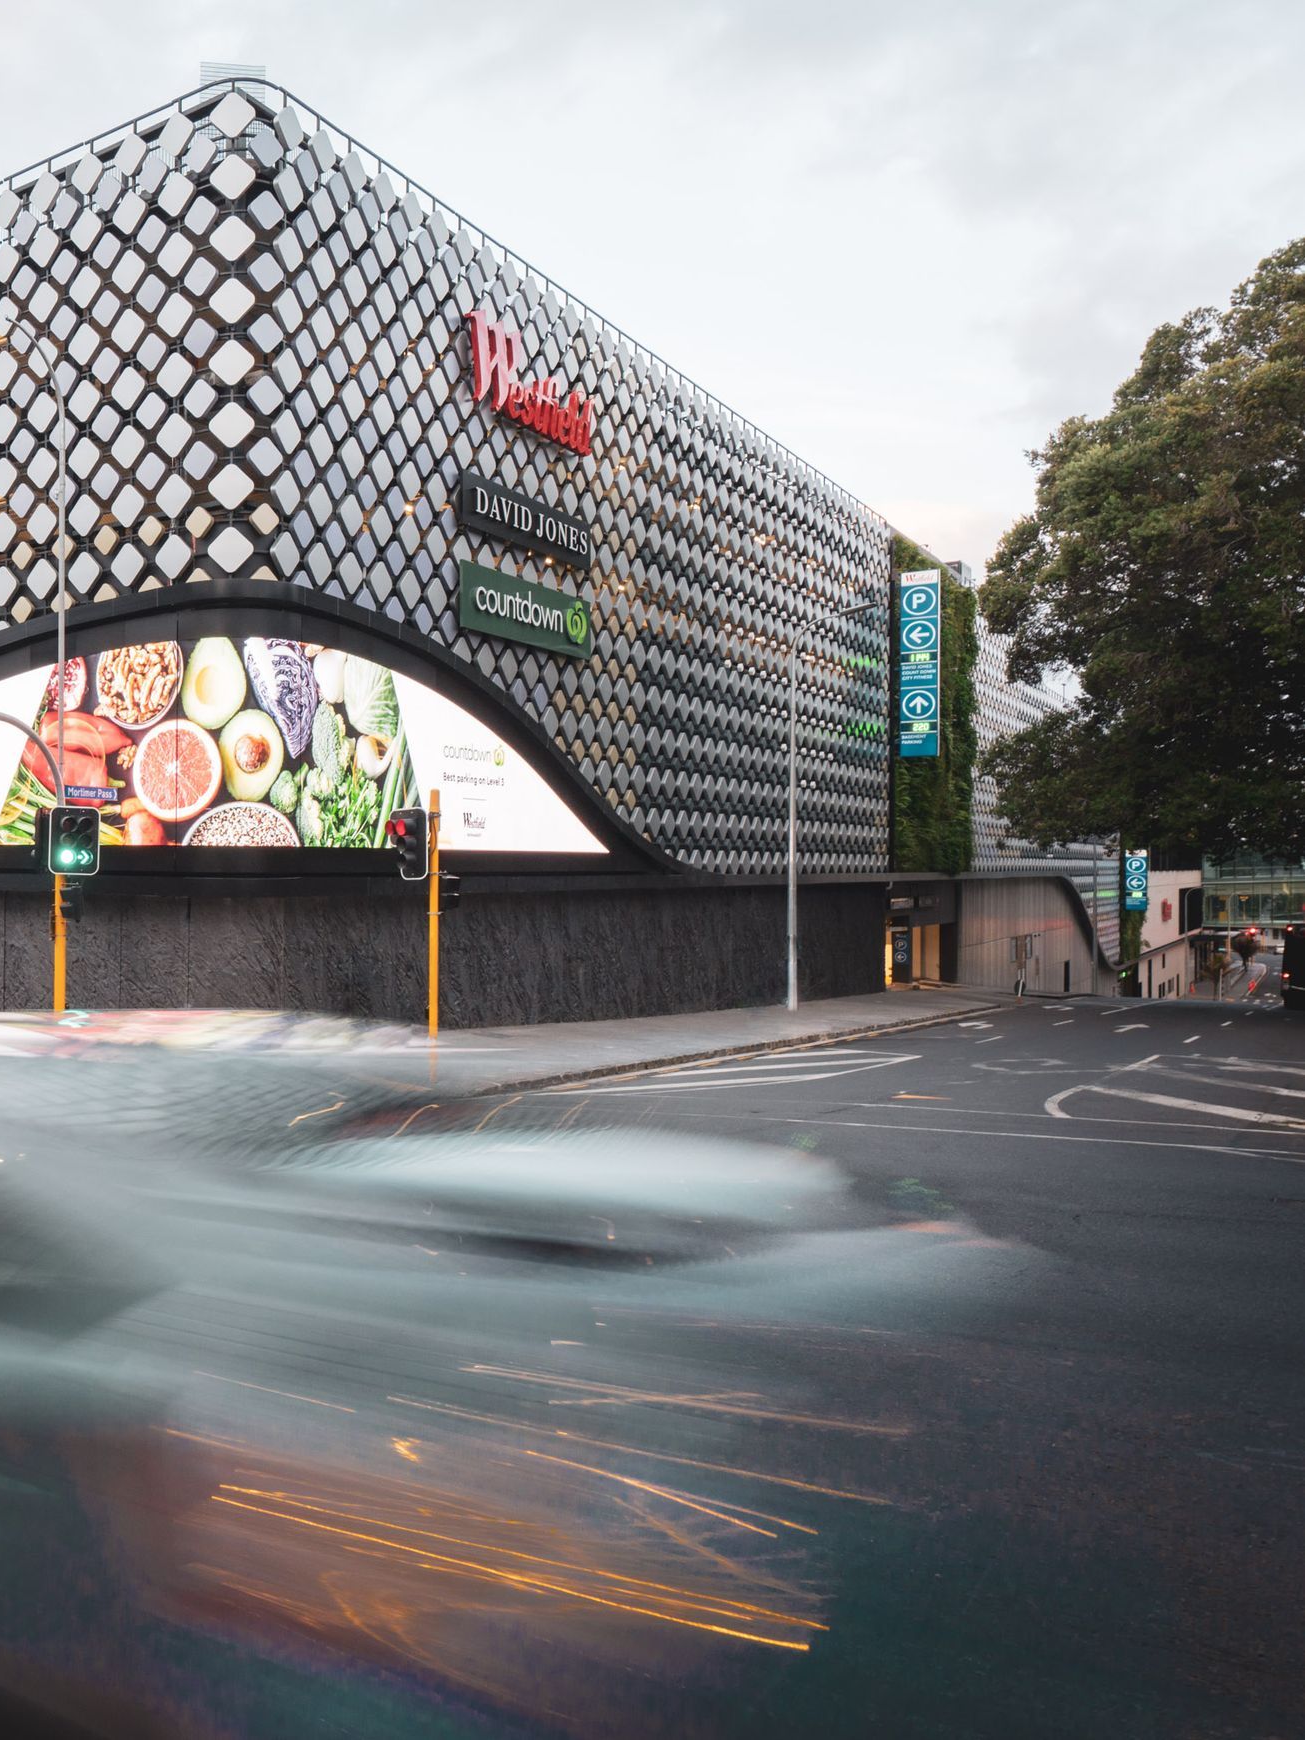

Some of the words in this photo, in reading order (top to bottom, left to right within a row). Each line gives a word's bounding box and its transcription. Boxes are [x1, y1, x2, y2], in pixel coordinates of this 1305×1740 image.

[465, 310, 595, 455] Westfield
[475, 486, 532, 532] DAVID
[536, 512, 588, 555] JONES
[475, 586, 563, 633] countdown
[912, 593, 926, 609] P
[443, 744, 491, 761] countdown
[443, 772, 455, 782] Best
[457, 773, 477, 786] parking
[478, 777, 486, 785] on
[487, 777, 500, 786] Level
[67, 787, 96, 797] Mortimer
[97, 788, 113, 799] Pass
[463, 812, 486, 829] Westfield
[1131, 860, 1141, 870] P
